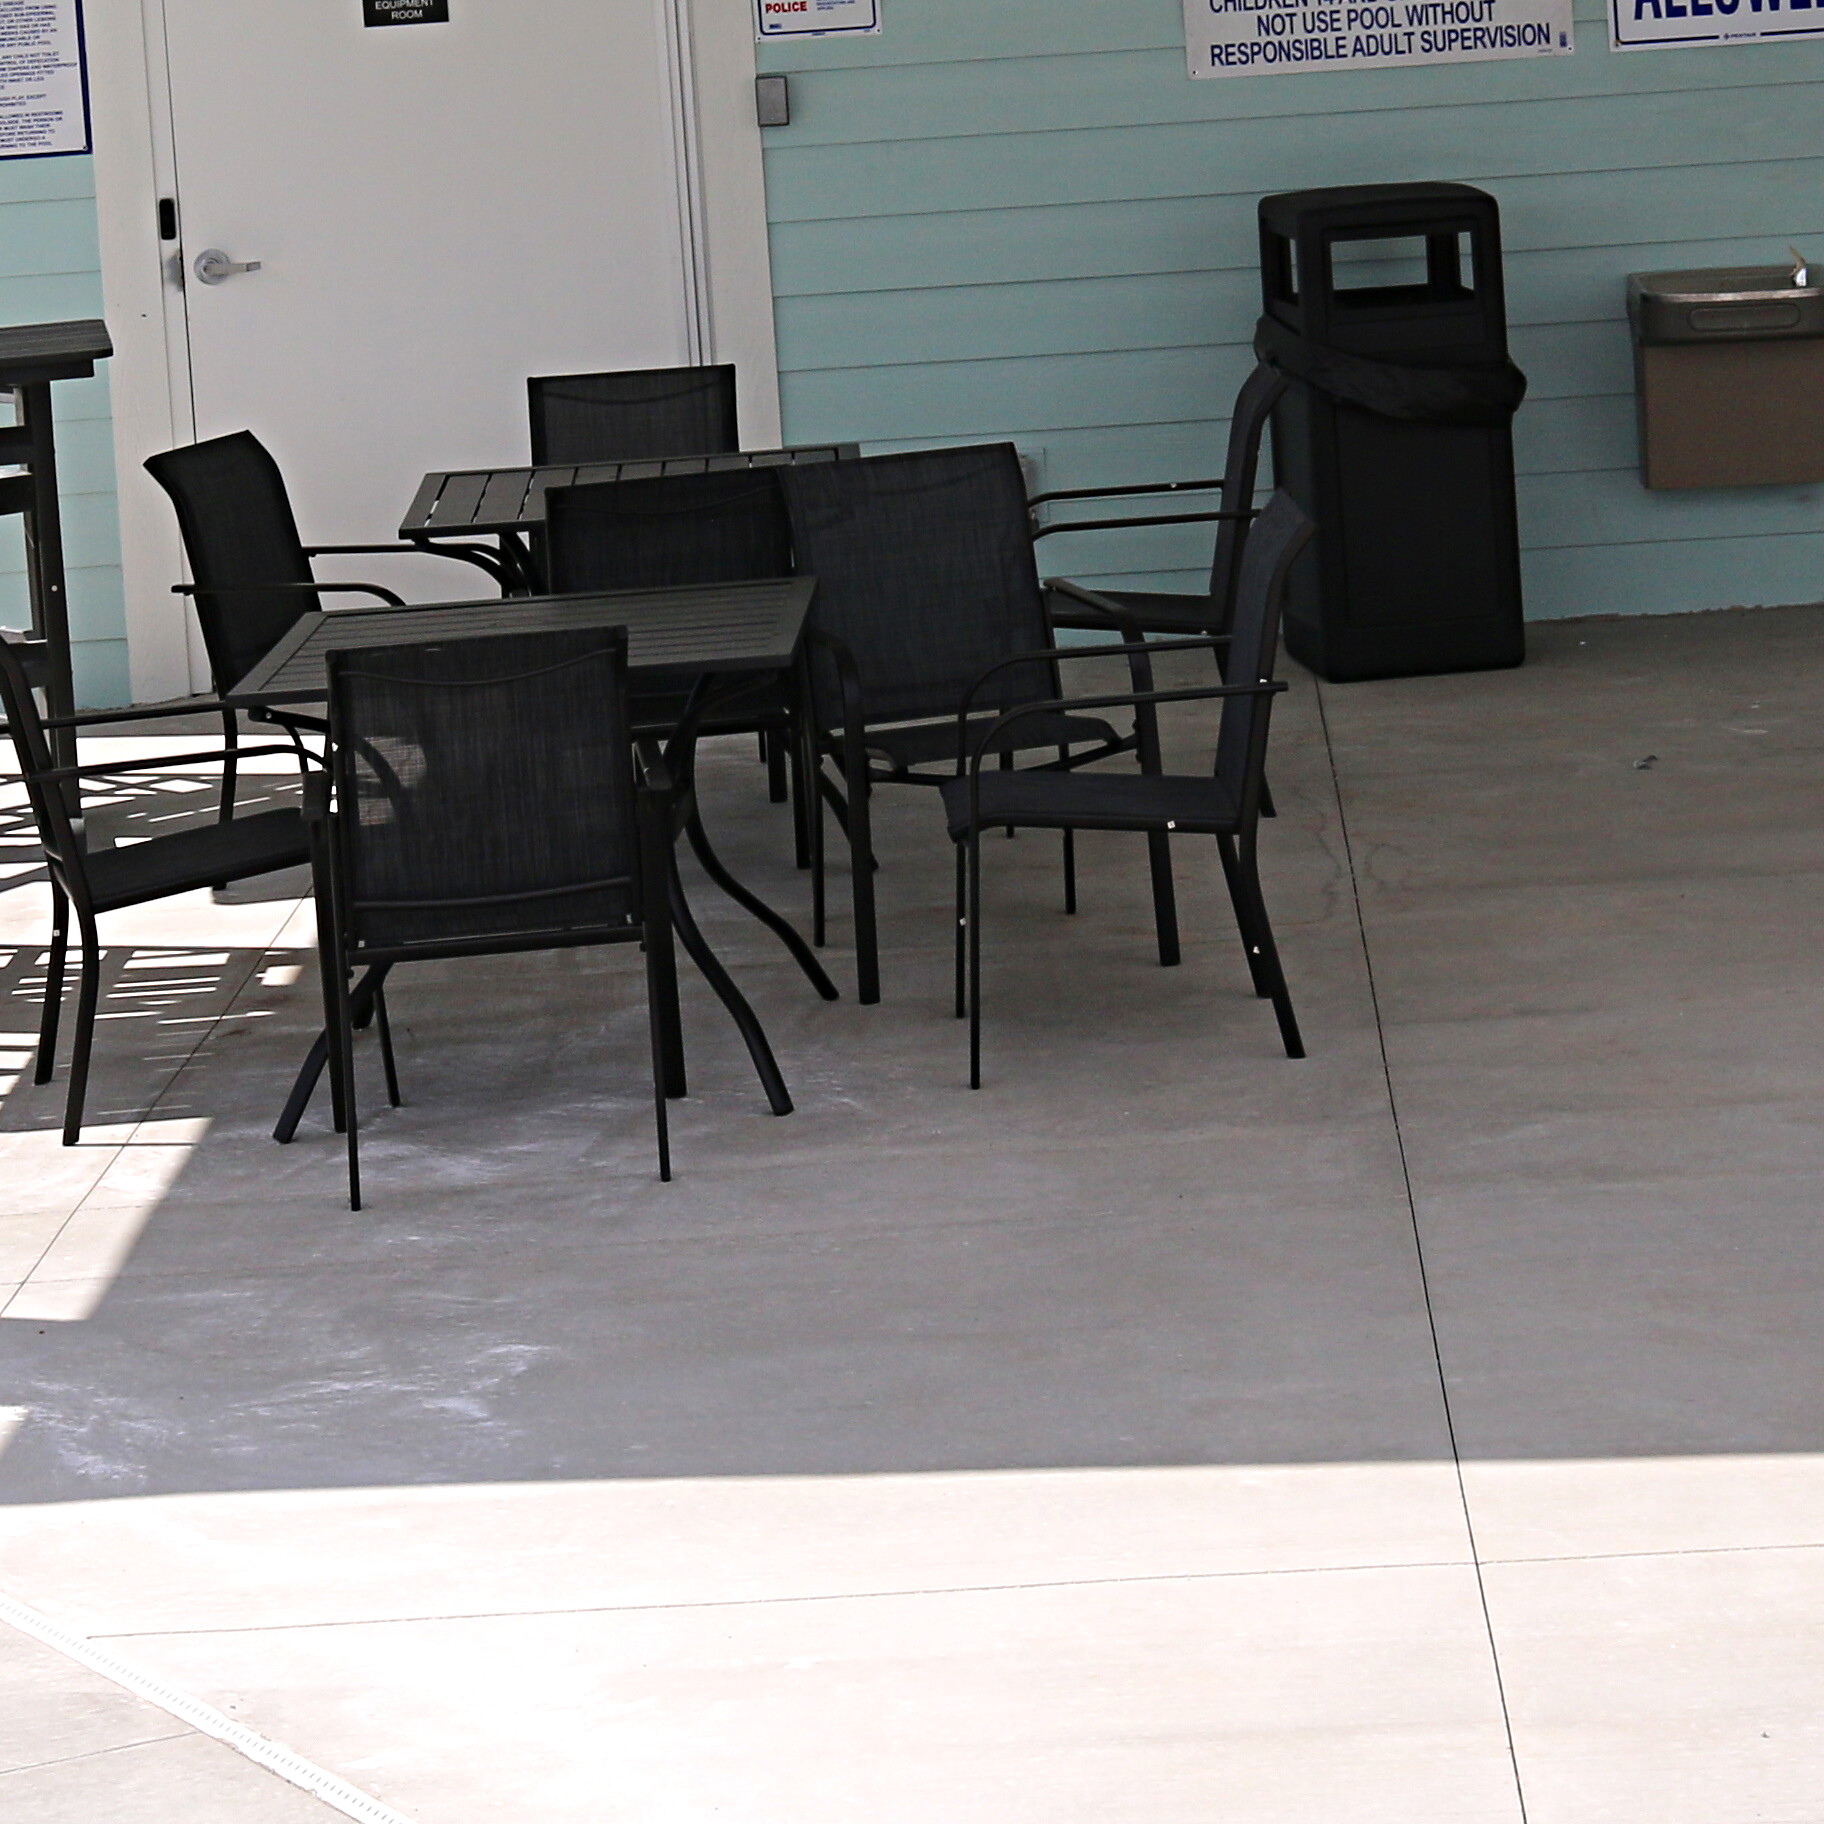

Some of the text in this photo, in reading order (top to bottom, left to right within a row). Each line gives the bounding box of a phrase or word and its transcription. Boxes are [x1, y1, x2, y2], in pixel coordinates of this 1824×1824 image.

[391, 9, 424, 20] ROOM
[765, 0, 807, 14] POLICE
[1256, 11, 1298, 37] NOT
[1302, 8, 1342, 34] USE
[1346, 4, 1402, 31] POOL
[1210, 35, 1348, 67] RESPONSIBLE
[1350, 31, 1416, 58] ADULT
[1419, 21, 1550, 53] SUPERVISION
